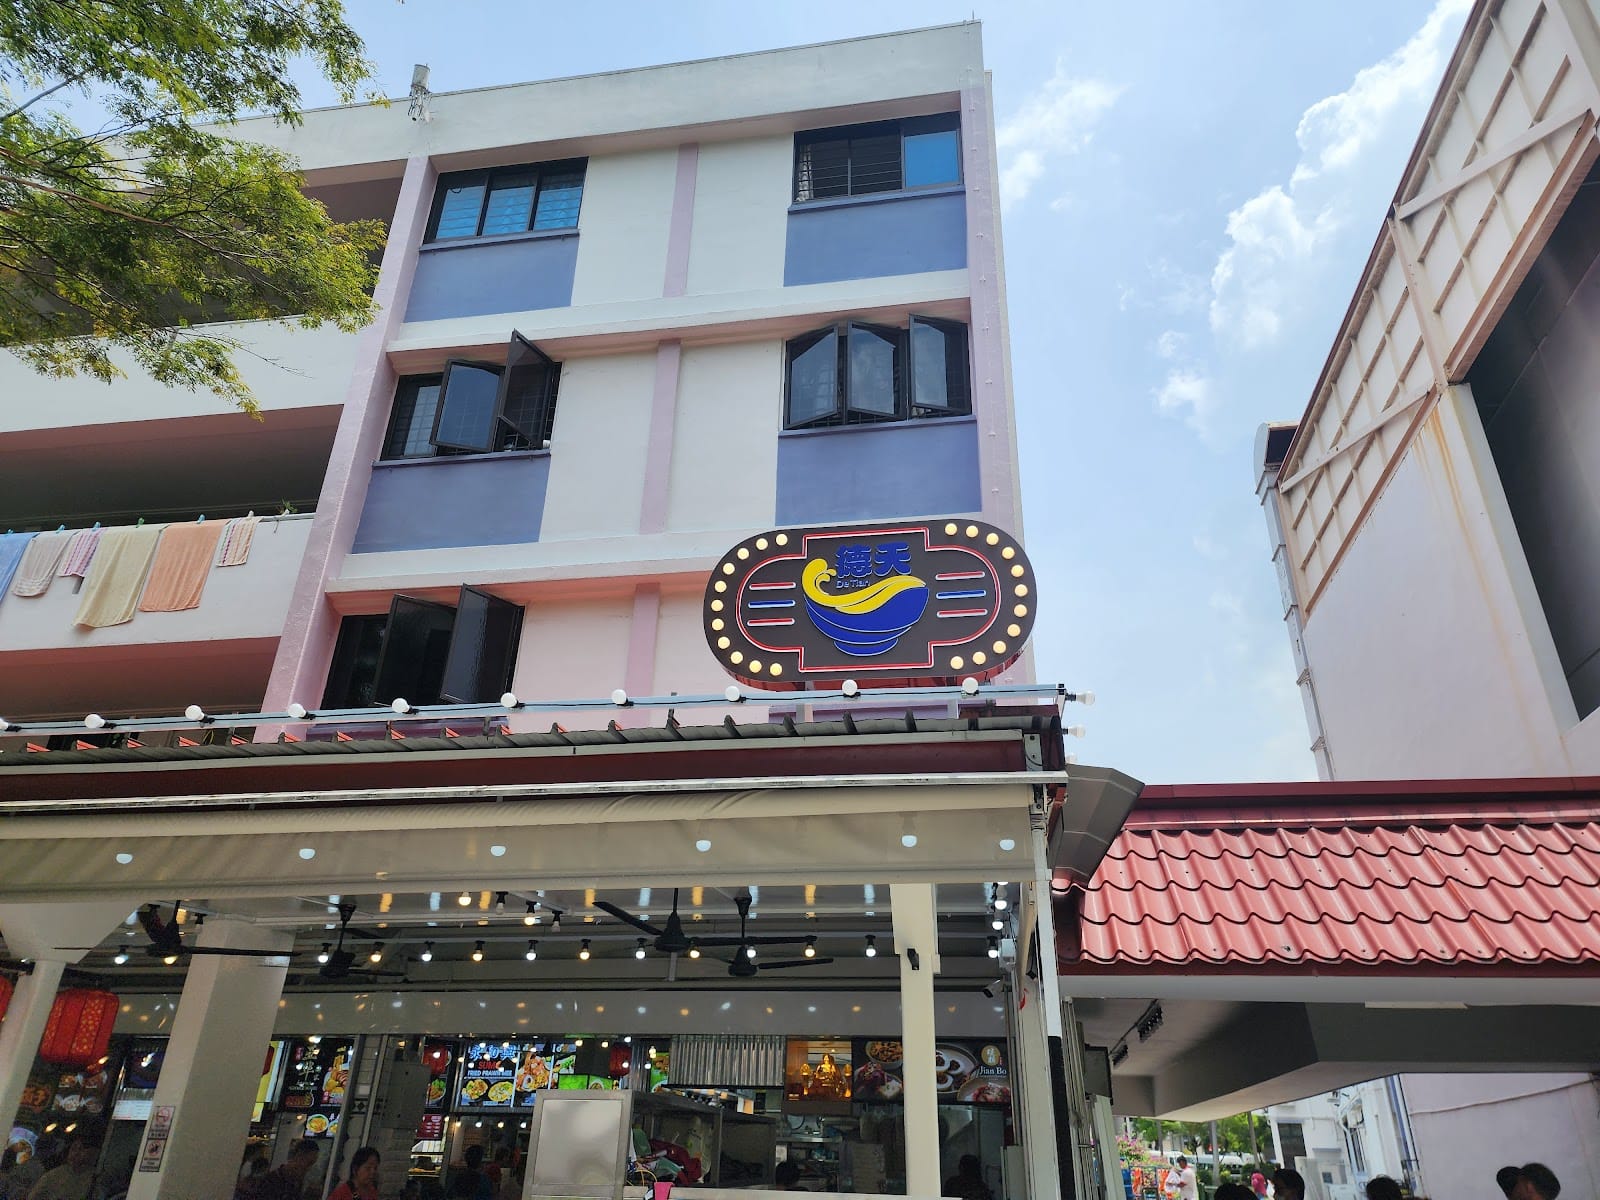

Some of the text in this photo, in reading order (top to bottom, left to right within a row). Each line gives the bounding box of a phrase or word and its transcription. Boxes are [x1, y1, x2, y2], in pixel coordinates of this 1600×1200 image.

[835, 541, 912, 578] 德天
[836, 580, 850, 588] De
[979, 1066, 1007, 1075] Jian Bo
